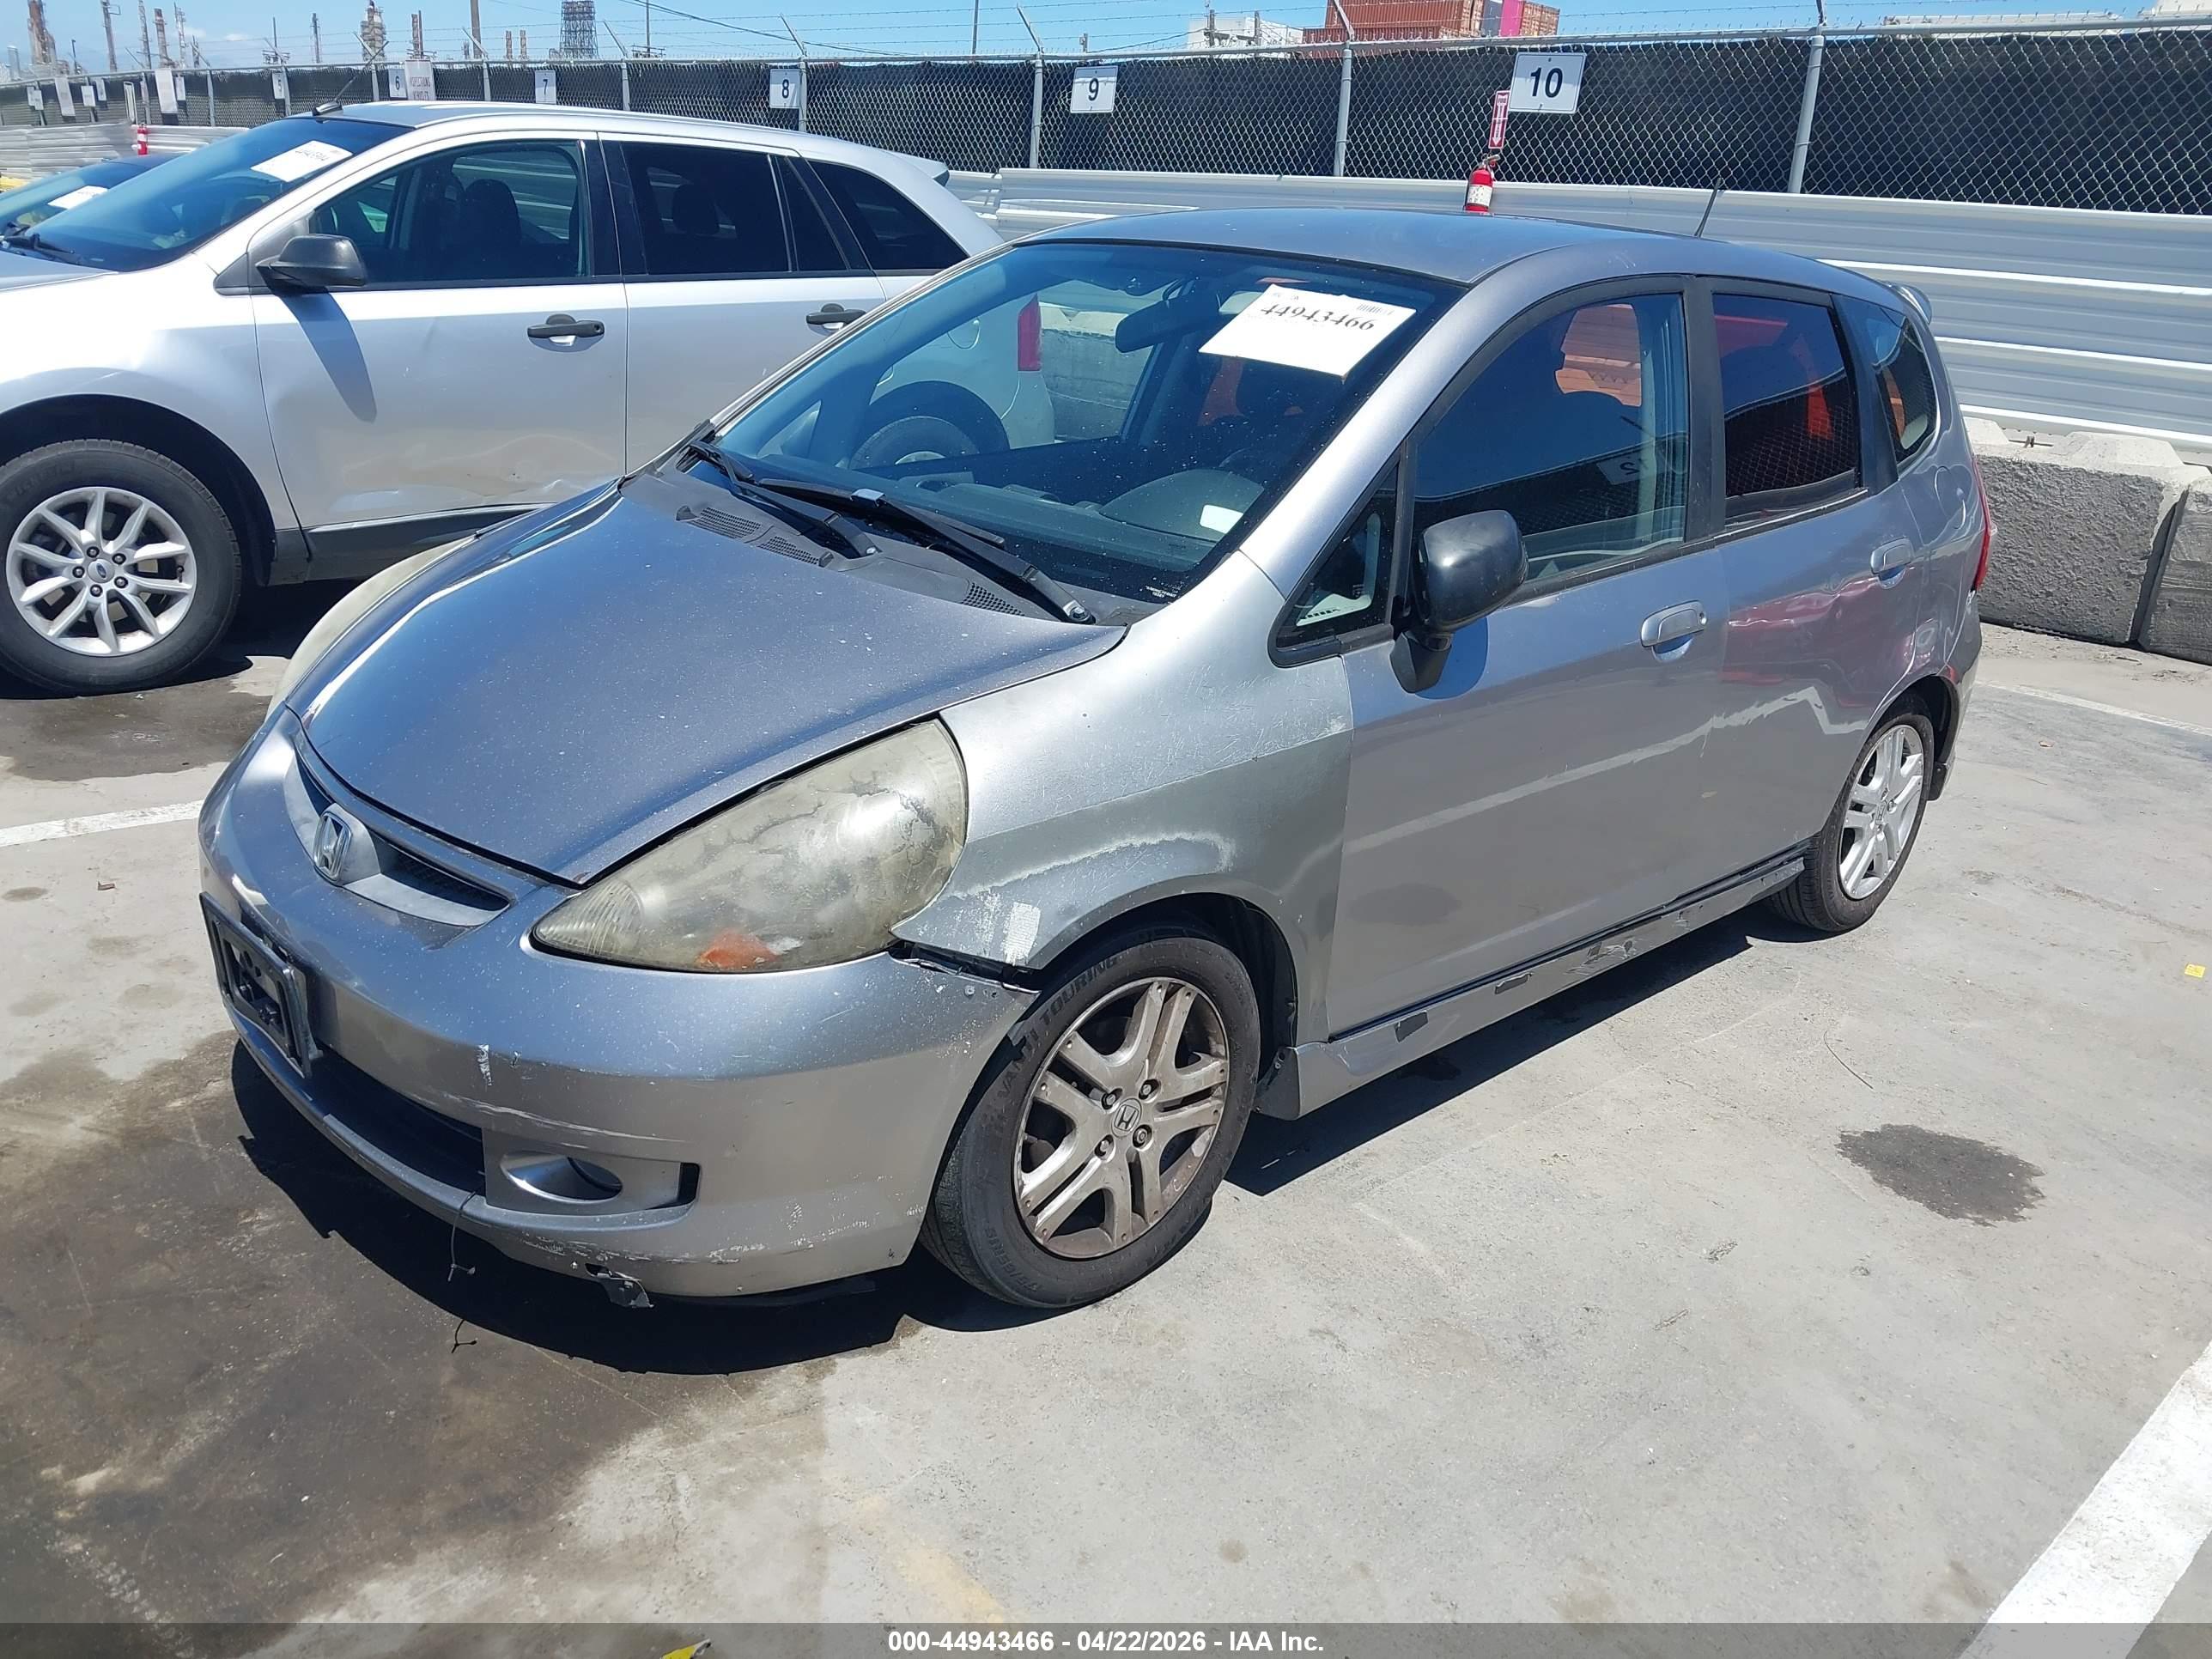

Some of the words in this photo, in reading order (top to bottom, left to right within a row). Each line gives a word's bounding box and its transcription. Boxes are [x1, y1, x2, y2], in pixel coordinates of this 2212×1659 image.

[395, 75, 400, 90] 6
[542, 78, 548, 95] 7
[781, 78, 790, 99] 8
[1088, 77, 1099, 101] 9
[1530, 67, 1563, 98] 10
[1261, 304, 1375, 331] 44943466
[1039, 957, 1115, 1026] TOURING
